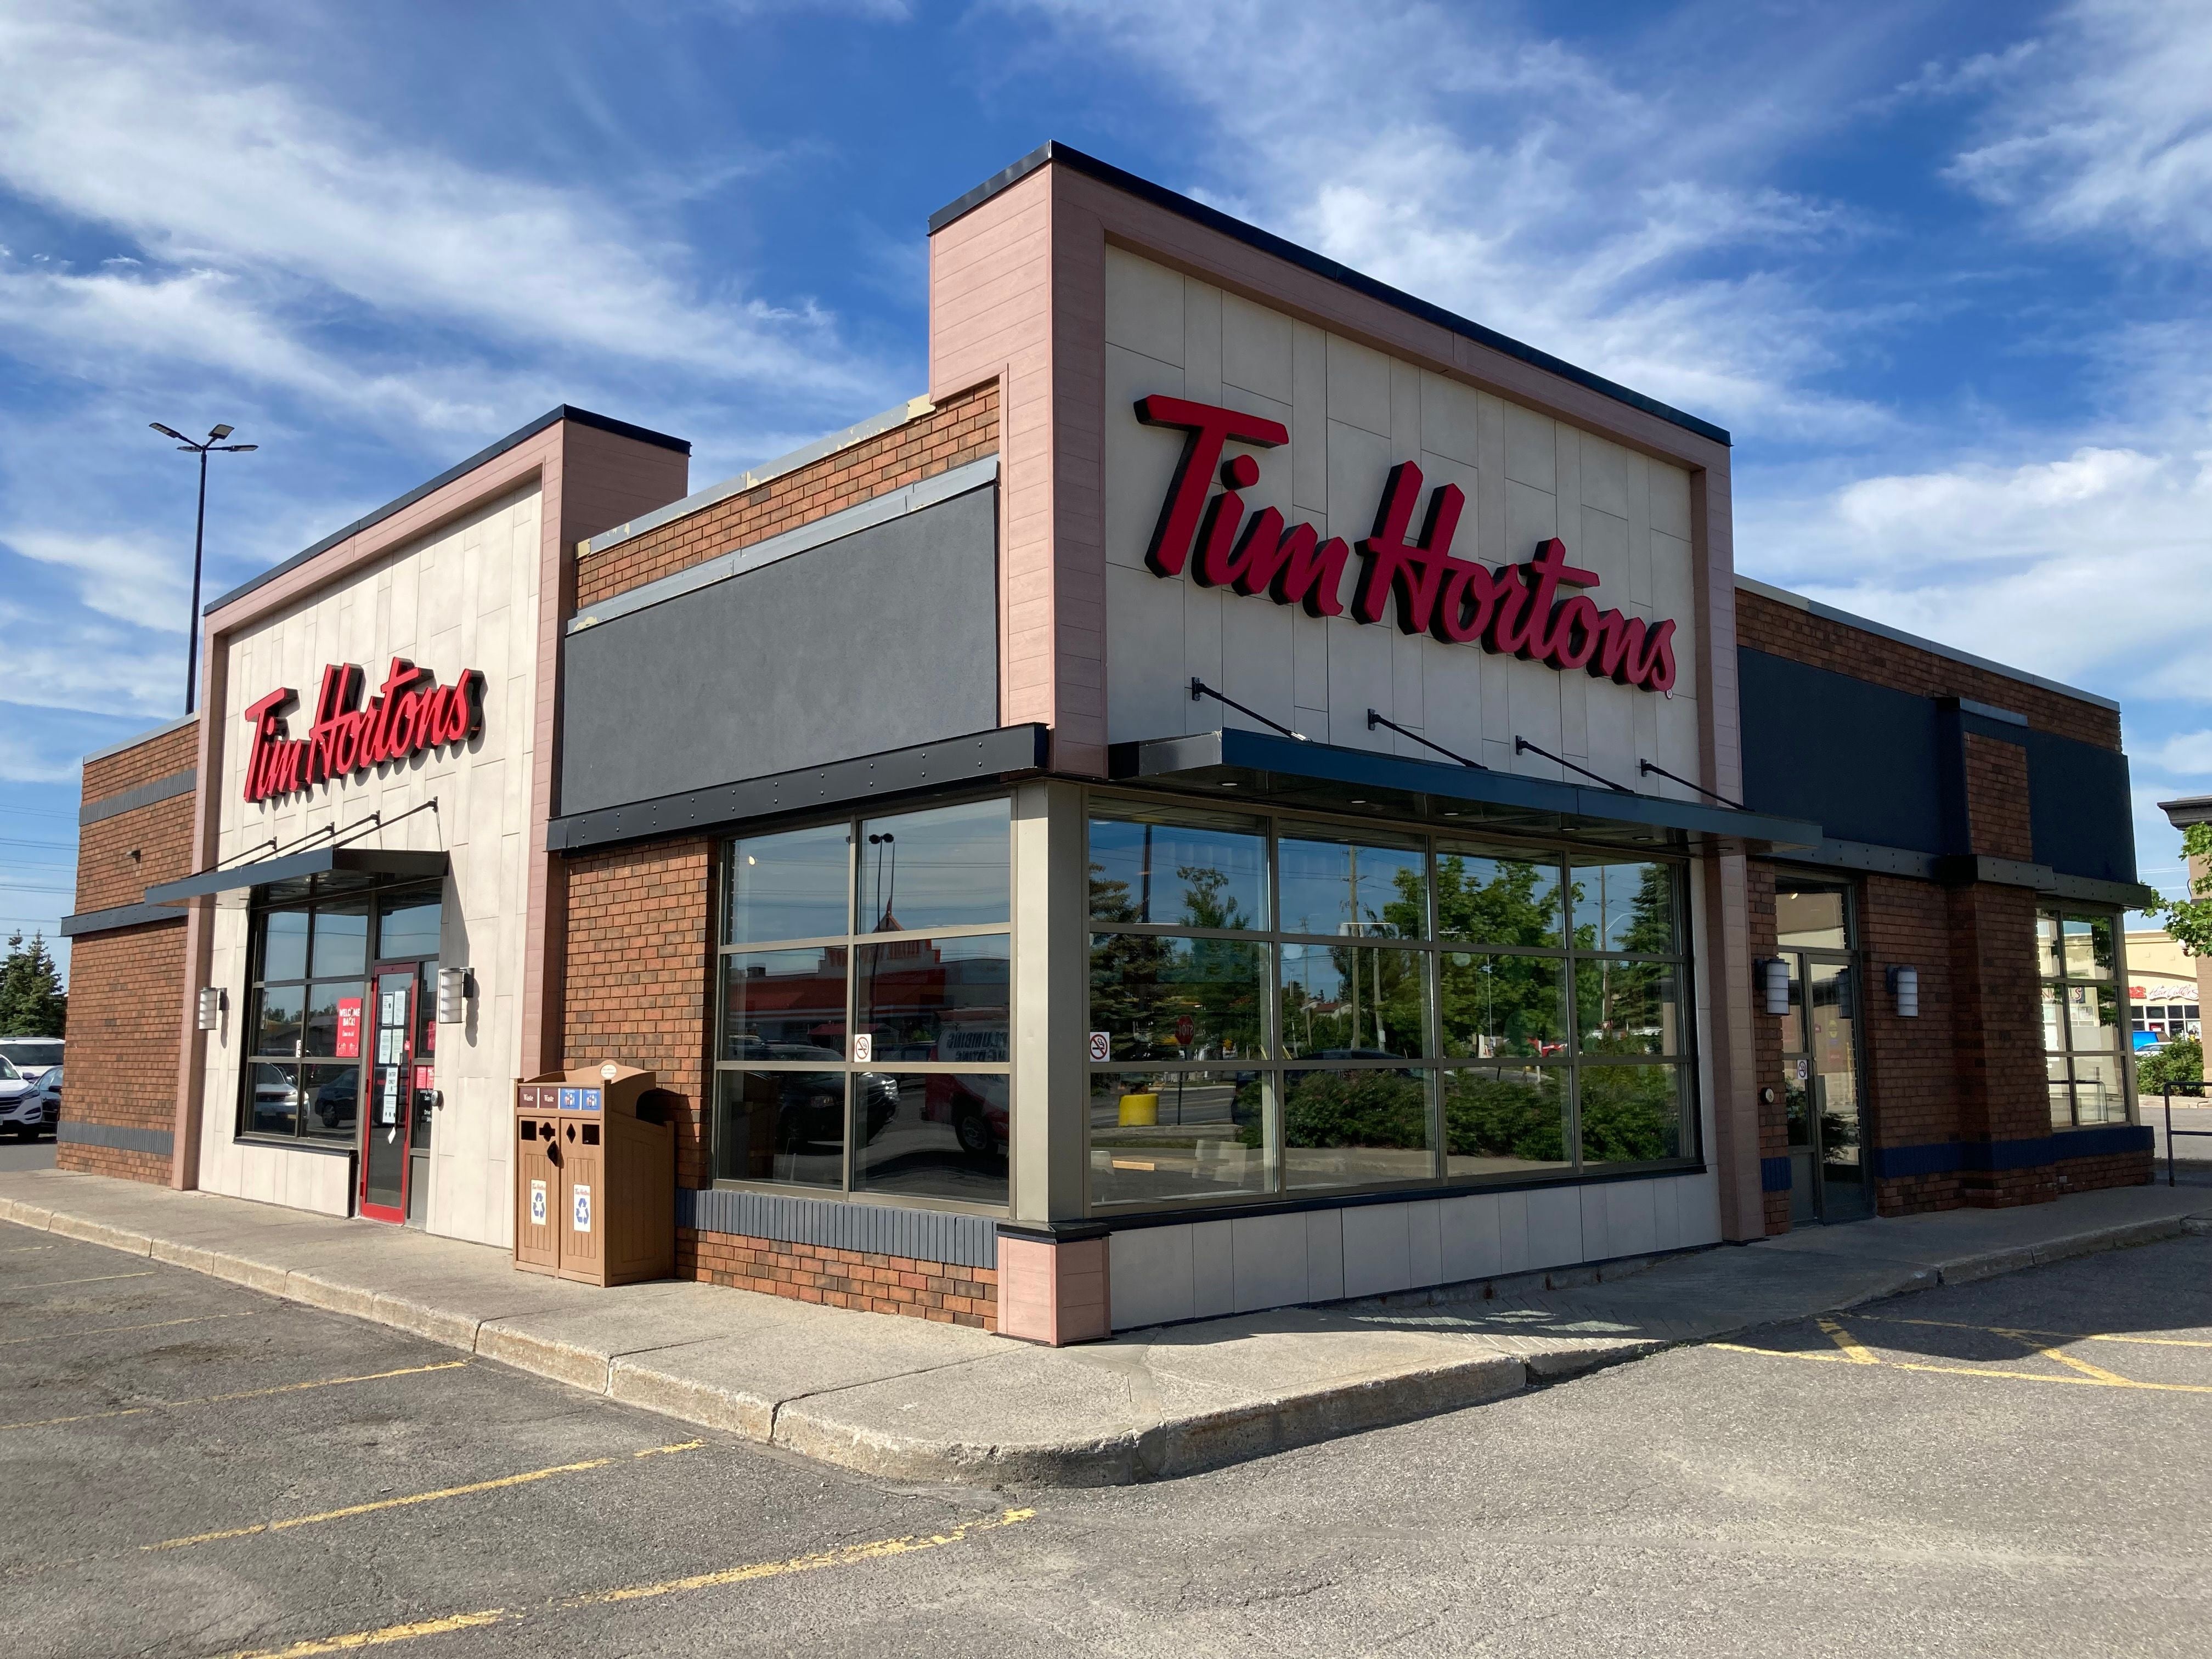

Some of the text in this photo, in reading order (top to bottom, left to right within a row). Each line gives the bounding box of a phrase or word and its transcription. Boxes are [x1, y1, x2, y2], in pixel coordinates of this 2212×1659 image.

[1133, 394, 1349, 618] Tim
[1351, 460, 1676, 693] Hortons
[244, 656, 476, 803] Tim Hortons
[339, 1008, 361, 1017] WELCOME
[523, 1094, 534, 1102] Waste
[544, 1094, 554, 1103] Waste
